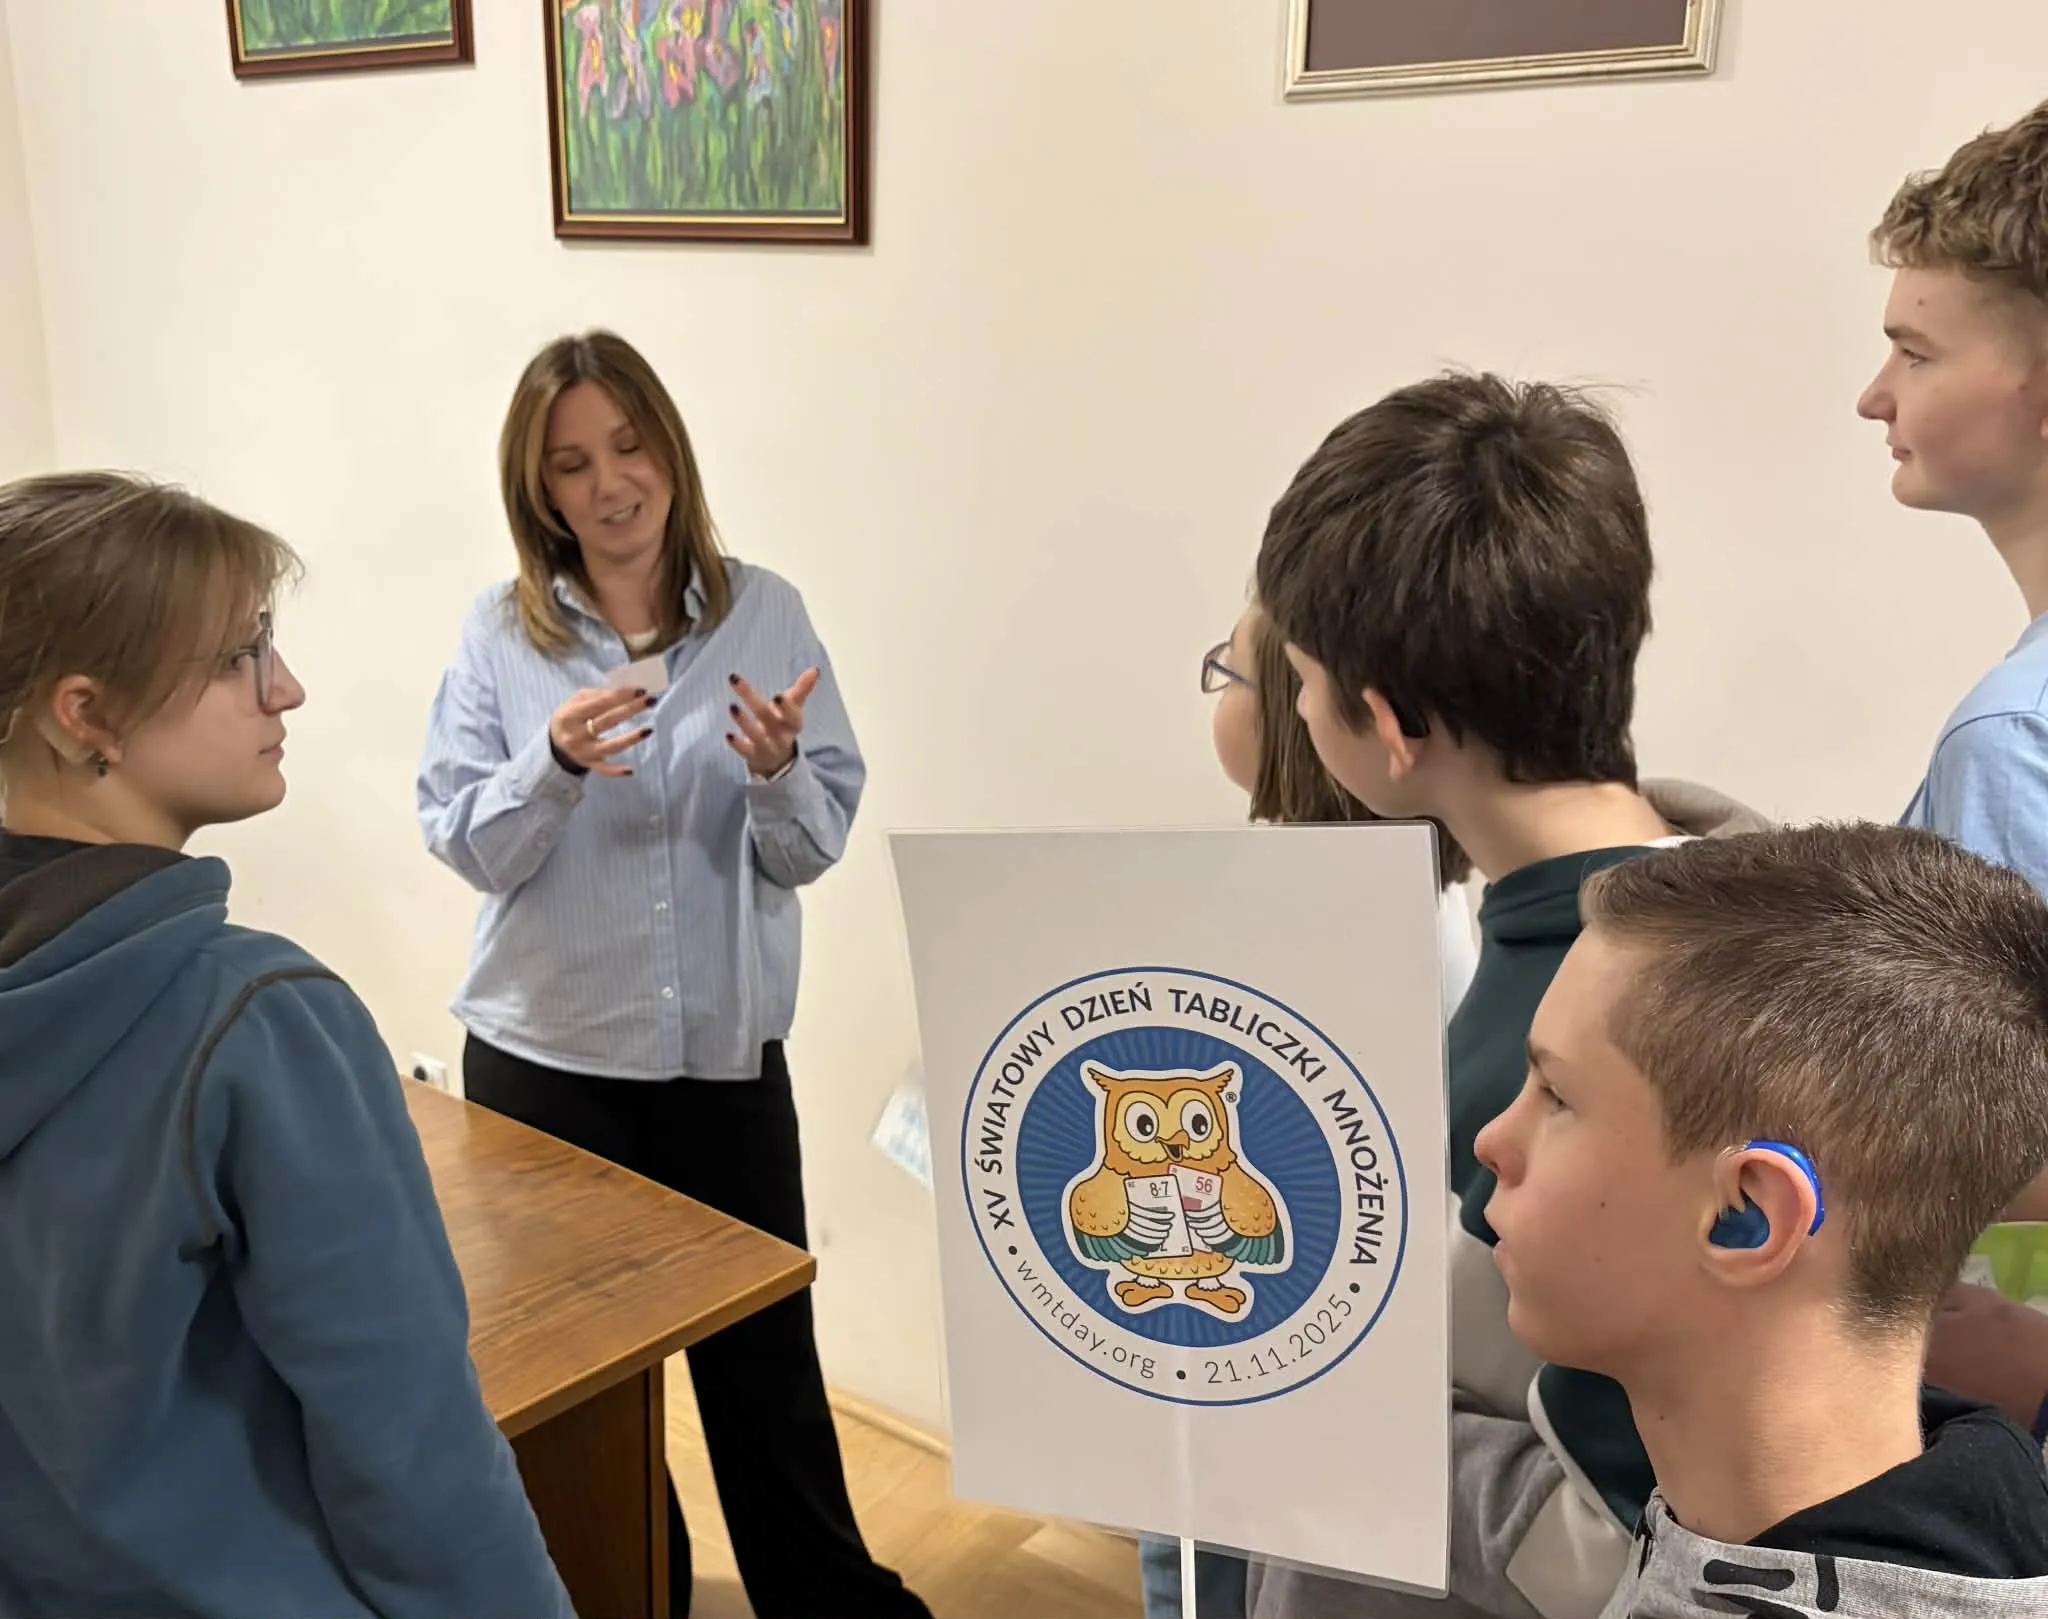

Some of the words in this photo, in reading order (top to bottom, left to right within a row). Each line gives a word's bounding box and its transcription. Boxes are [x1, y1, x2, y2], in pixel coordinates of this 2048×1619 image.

[1059, 981, 1153, 1032] DZIEŃ
[1167, 988, 1328, 1083] TABLICZKI
[974, 1021, 1056, 1175] ŚWIATOWY
[983, 1188, 1015, 1231] XV
[1195, 1176, 1213, 1194] 56
[1322, 1088, 1389, 1265] MNOŻENIA
[1017, 1260, 1156, 1380] wmtday.org
[1204, 1293, 1353, 1385] 21.11.2025
